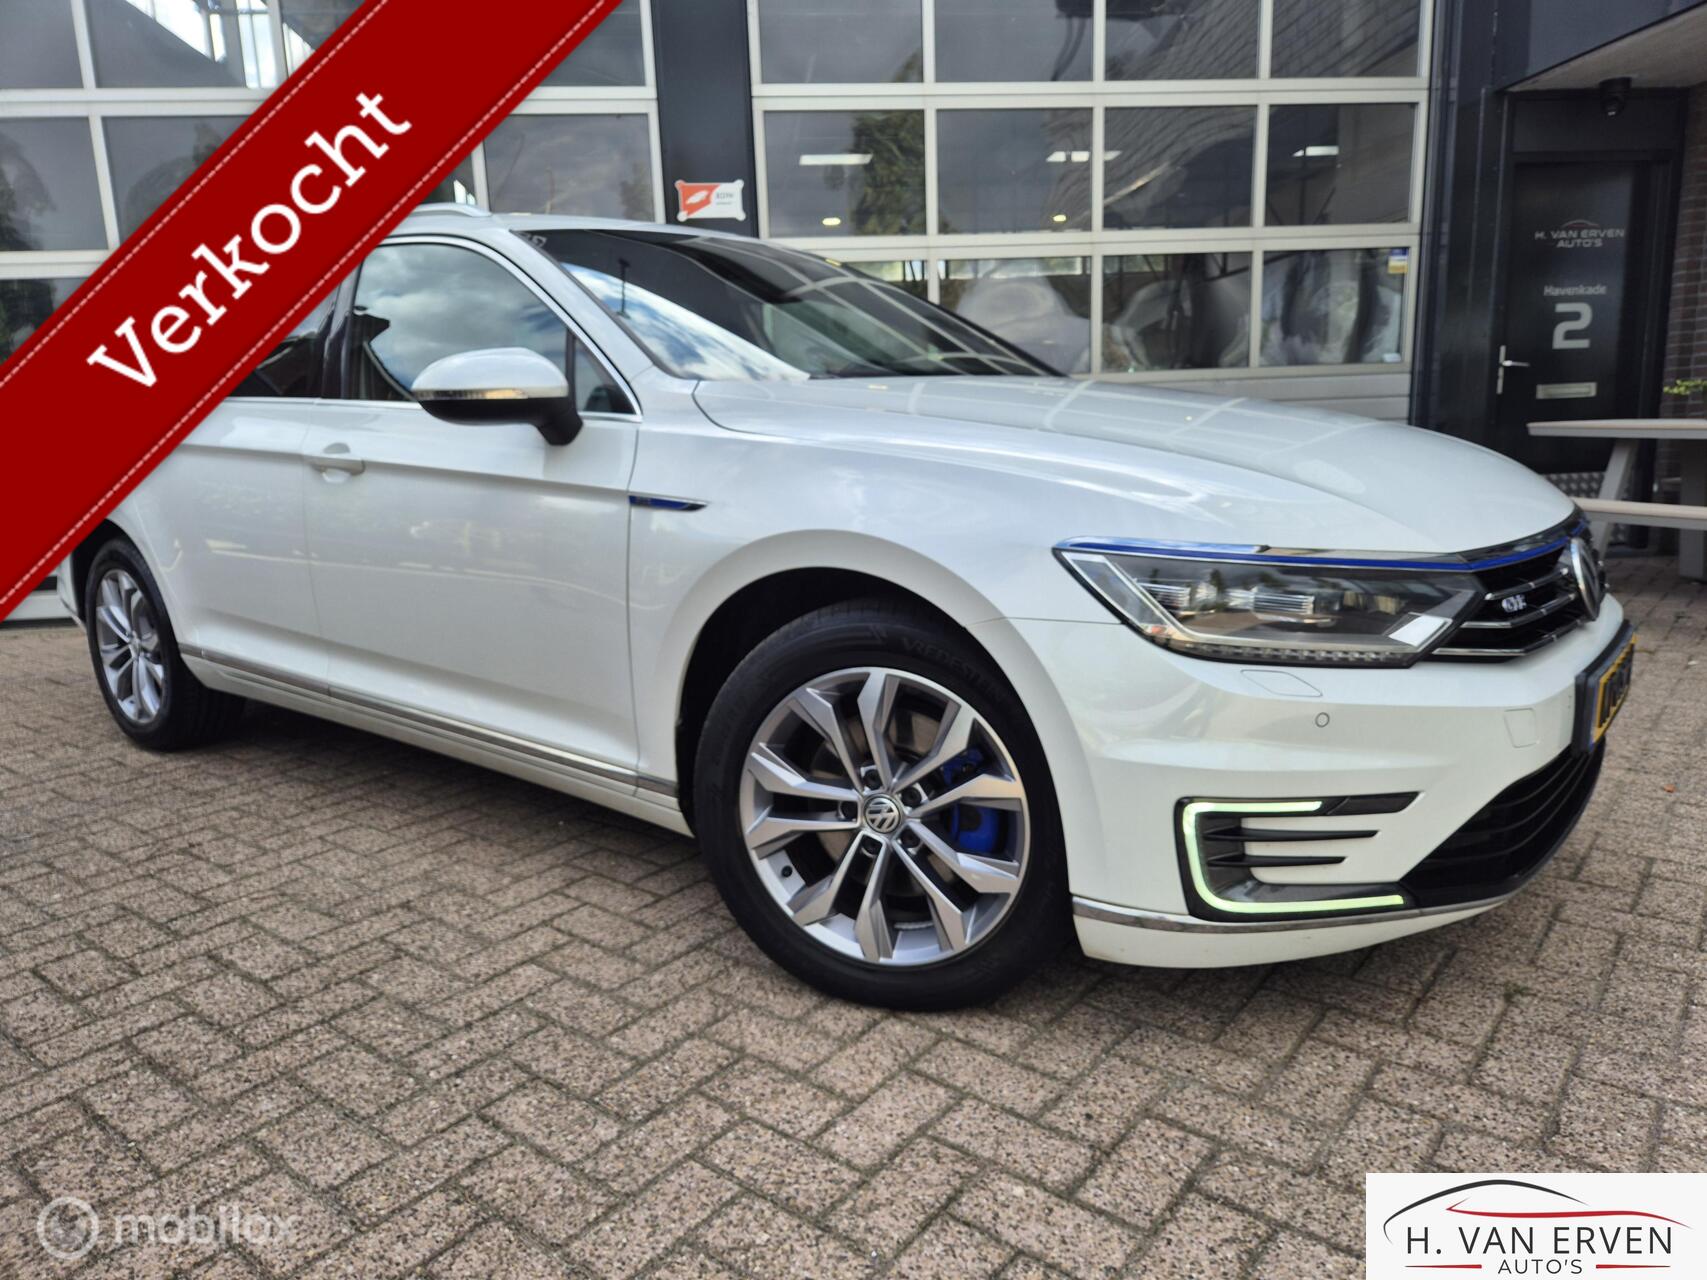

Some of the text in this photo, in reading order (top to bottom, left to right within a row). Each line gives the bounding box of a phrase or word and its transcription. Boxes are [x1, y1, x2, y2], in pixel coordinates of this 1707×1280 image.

[1551, 230, 1577, 240] VAN
[1580, 228, 1625, 239] ERVEN
[1556, 238, 1603, 248] AUTO'S
[1543, 284, 1607, 297] Havenkade
[1552, 302, 1593, 349] 2
